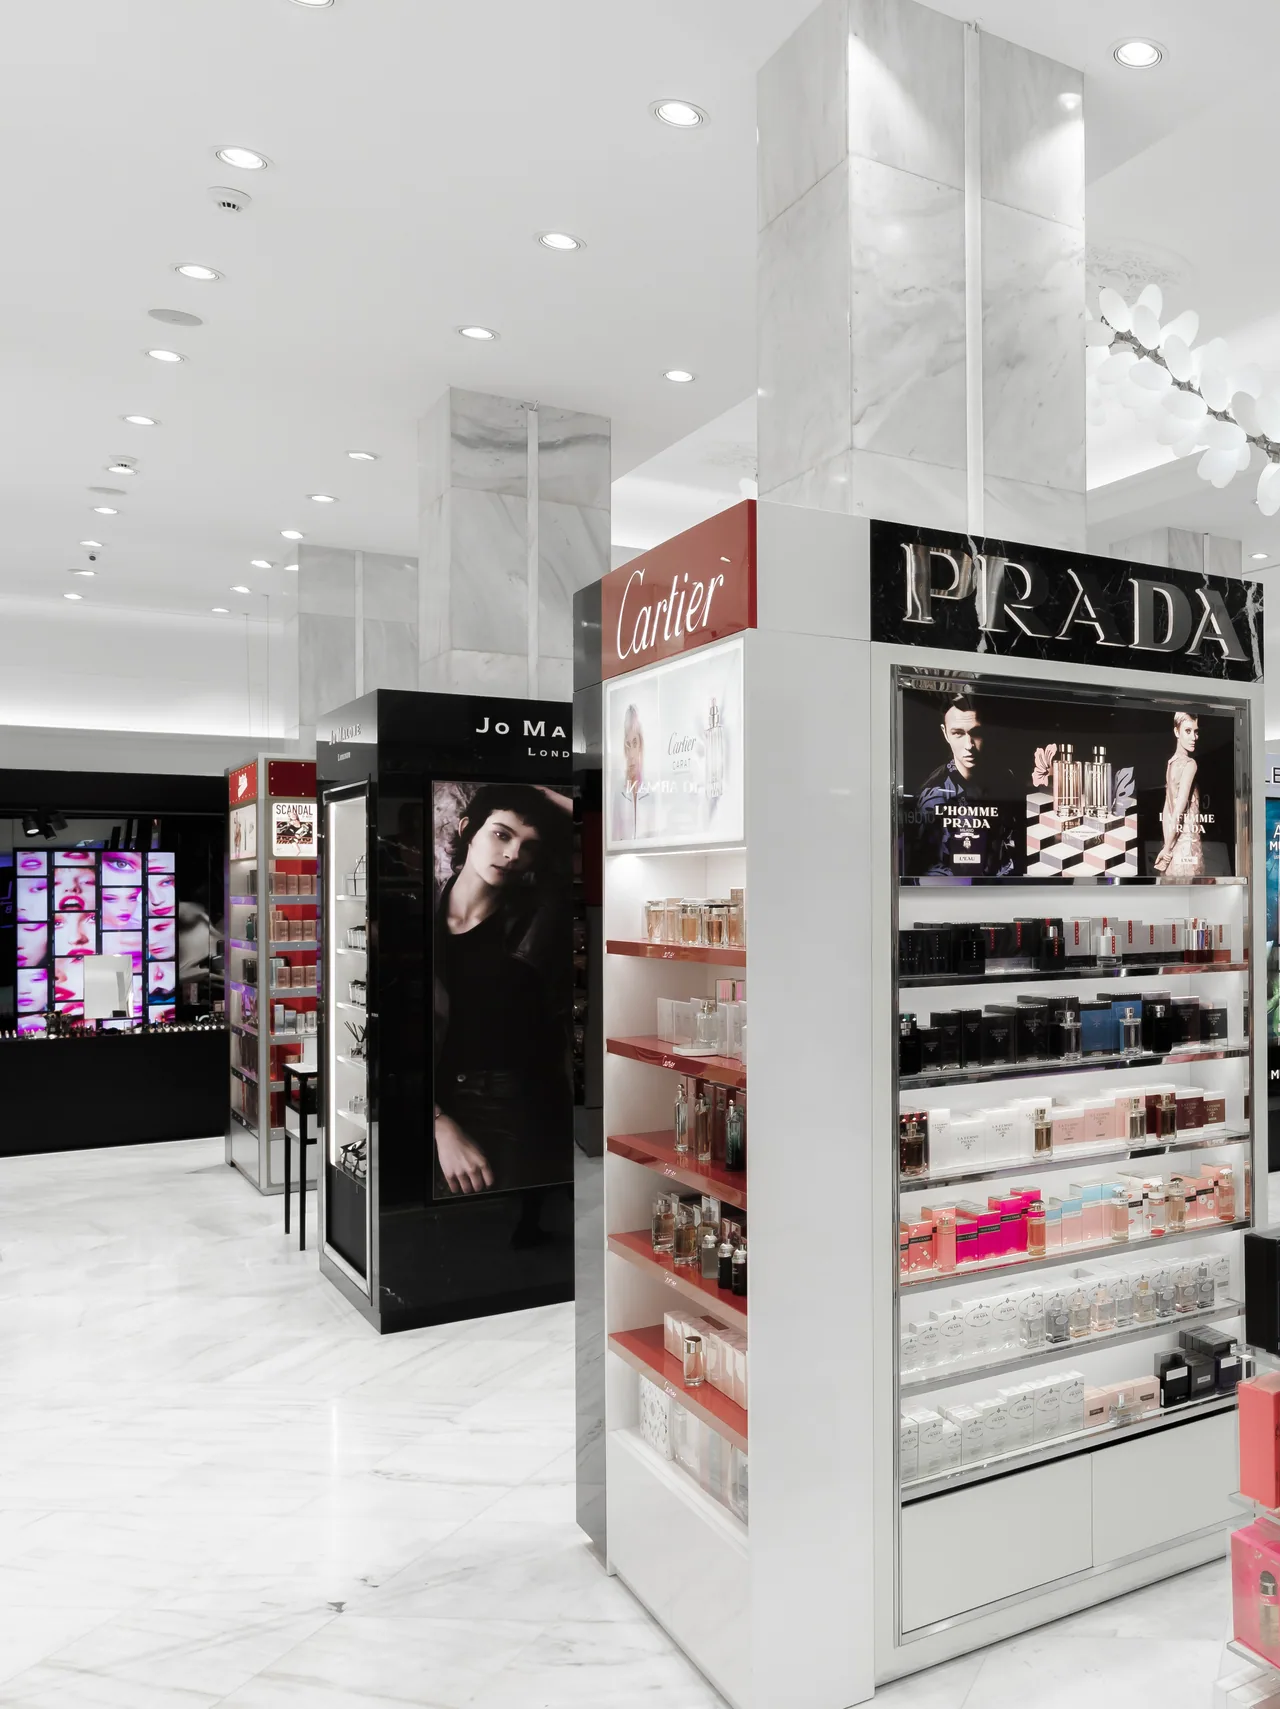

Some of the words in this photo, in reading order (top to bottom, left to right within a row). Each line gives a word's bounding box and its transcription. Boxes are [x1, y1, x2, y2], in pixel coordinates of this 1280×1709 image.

[900, 542, 1251, 662] PRADA
[616, 567, 724, 660] Cartier
[667, 731, 697, 756] Cartier
[672, 758, 691, 771] CARAT
[276, 804, 314, 816] SCANDAL
[935, 805, 999, 817] L'HOMME
[943, 817, 991, 829] PRADA
